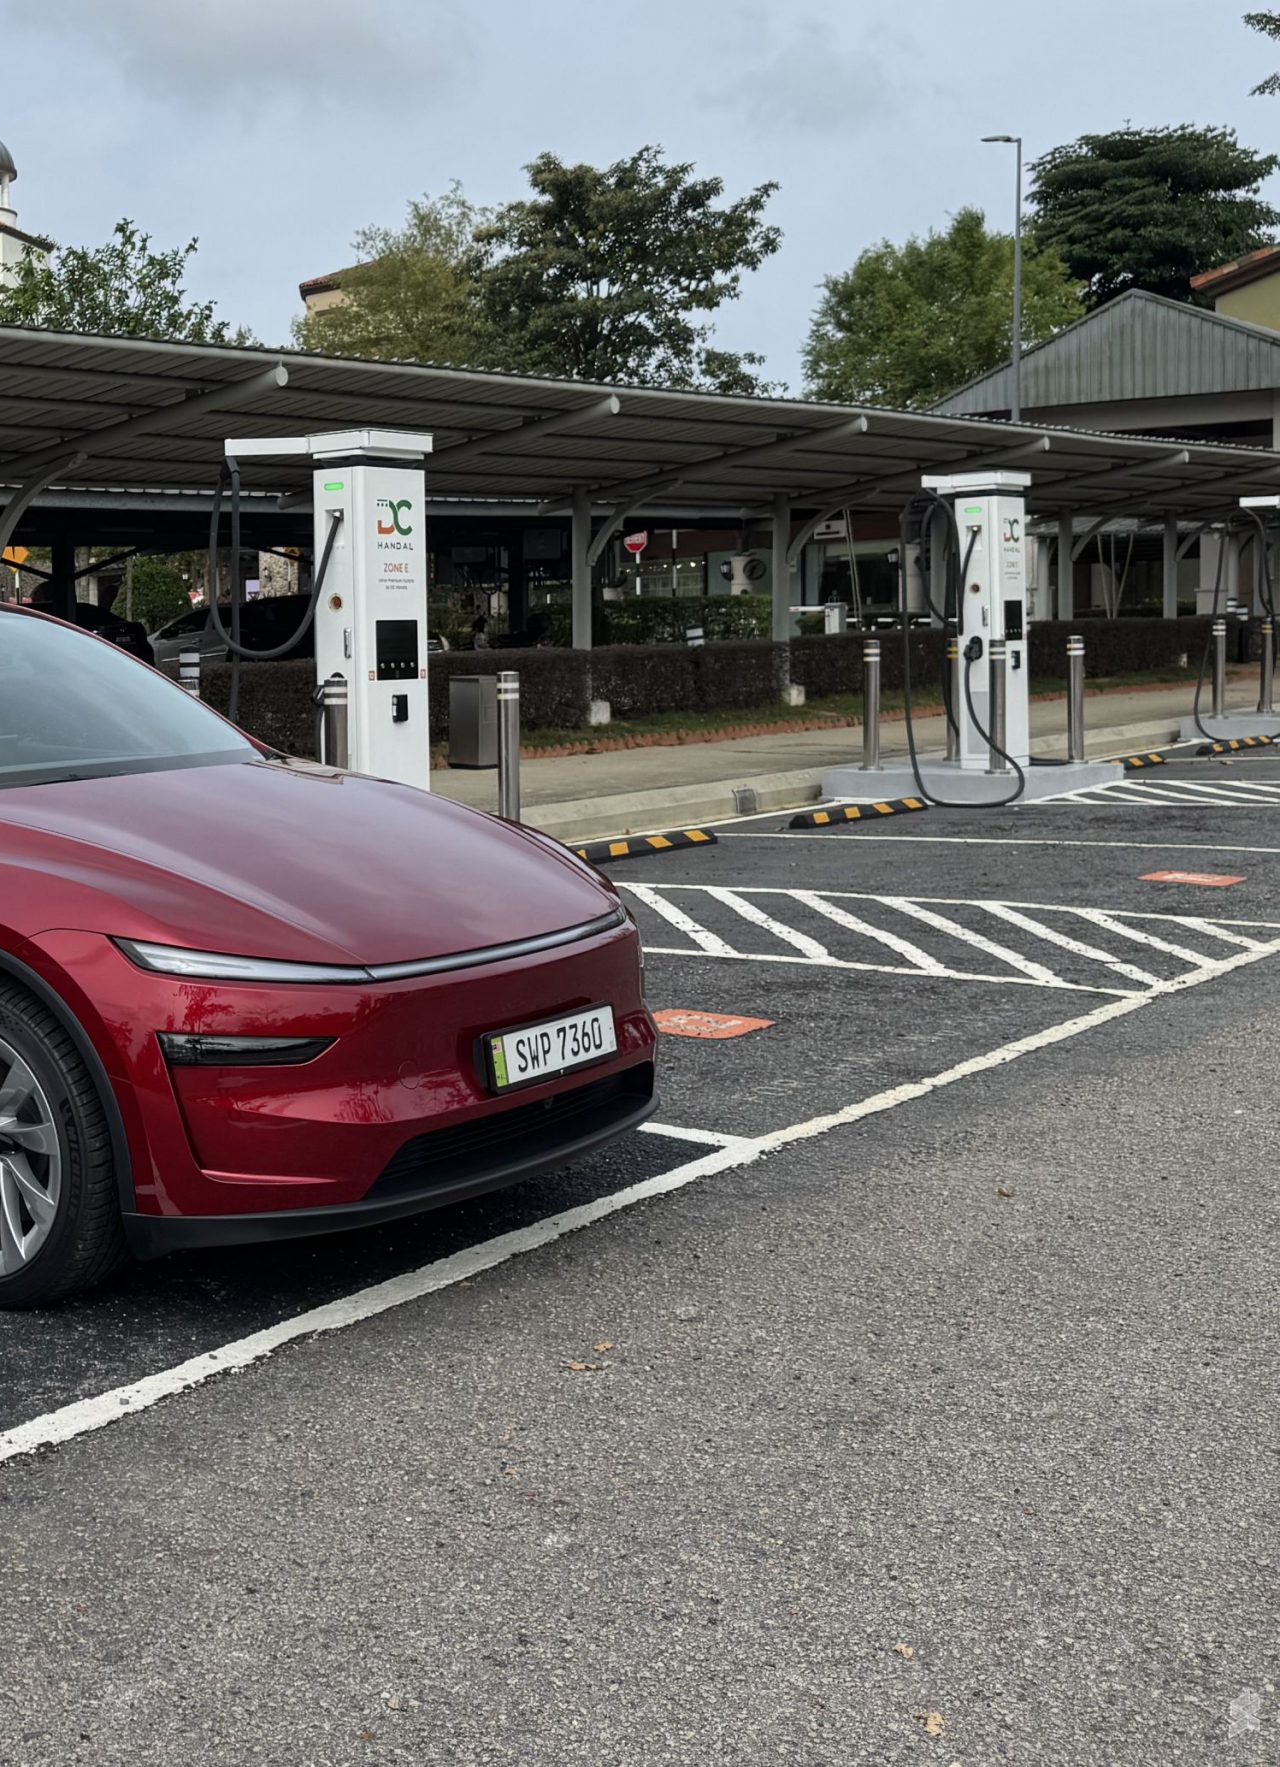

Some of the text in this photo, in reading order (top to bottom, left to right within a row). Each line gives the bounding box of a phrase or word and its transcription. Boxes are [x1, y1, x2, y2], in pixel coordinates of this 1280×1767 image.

[377, 541, 414, 551] HANDAL
[383, 562, 409, 573] ZONE E
[515, 1017, 603, 1073] SWP 7360
